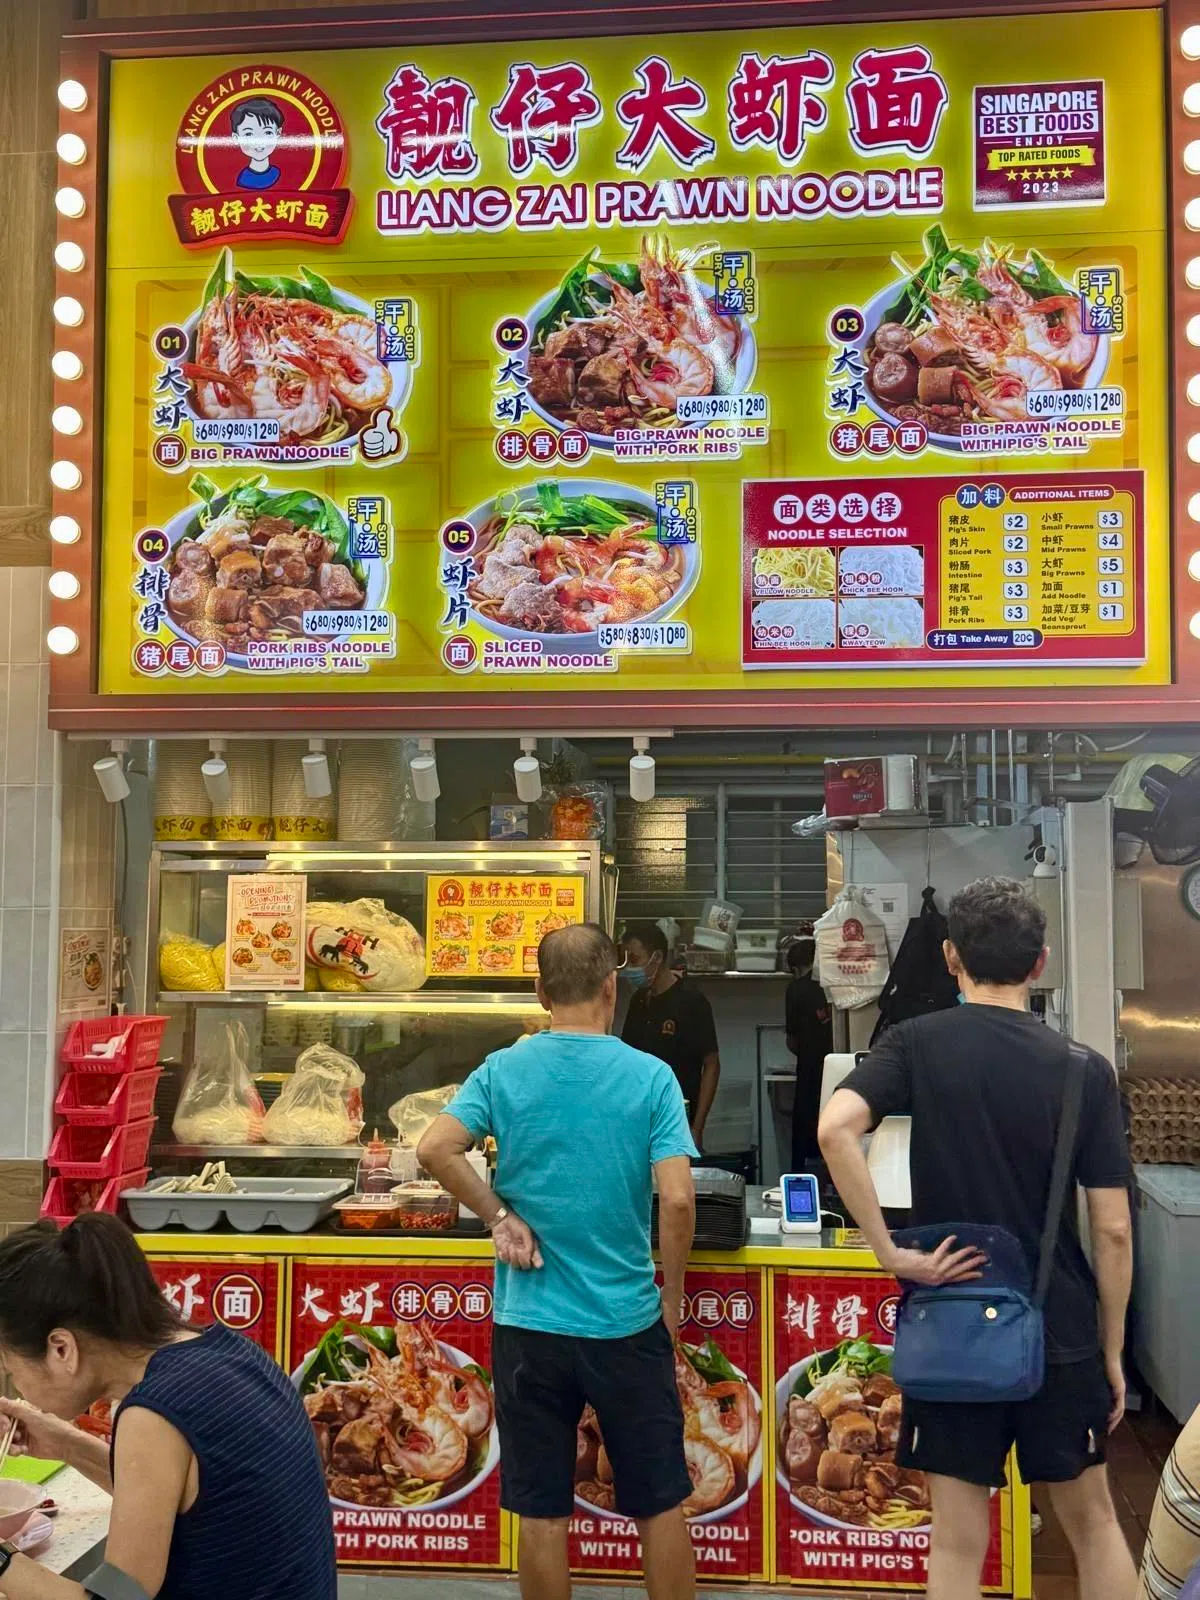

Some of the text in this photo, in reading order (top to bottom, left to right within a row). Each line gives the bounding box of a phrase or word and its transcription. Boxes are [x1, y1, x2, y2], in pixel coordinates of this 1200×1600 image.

[980, 90, 1098, 115] SINGAPORE
[182, 71, 341, 154] LIANG ZAI PRAWN NOODLE
[378, 47, 946, 177] 靓仔大虾面
[983, 112, 1094, 135] BEST FOODS
[1015, 135, 1064, 147] ENJOY
[998, 149, 1081, 163] TOP RATED FOODS
[1023, 181, 1059, 194] 2023
[381, 171, 942, 227] LIANG ZAI PRAWN NOODLE
[189, 196, 330, 236] 靓仔大虾面
[714, 254, 722, 278] DRY
[1080, 271, 1089, 295] DRY
[745, 278, 754, 312] SOUP
[375, 301, 386, 325] DRY
[1112, 296, 1122, 331] SOUP
[836, 319, 858, 332] 03
[404, 325, 415, 360] SOUP
[501, 329, 523, 342] 02
[160, 336, 180, 350] 01
[616, 427, 765, 441] BIG PRAWN NOODLE
[962, 420, 1121, 436] BIG PRAWN NOODLE
[837, 426, 921, 449] 猪尾面
[961, 436, 1087, 451] WITH PIG'S TAIL
[161, 441, 180, 461] 面
[190, 445, 350, 461] BIG PRAWN NOODLE
[502, 435, 584, 457] 排骨面
[616, 441, 738, 456] WITH PORK RIBS
[656, 483, 665, 506] DRY
[961, 488, 1001, 505] 加料
[1014, 489, 1110, 500] ADDITIONAL ITEMS
[349, 499, 358, 522] DRY
[779, 497, 897, 520] 面类选择
[949, 515, 970, 526] 猪皮
[1007, 515, 1024, 528] $2
[1042, 512, 1064, 523] 小虾
[1102, 513, 1119, 526] $3
[686, 508, 696, 542] SOUP
[1065, 523, 1094, 531] Prawns
[378, 524, 387, 557] SOUP
[448, 530, 469, 544] 05
[768, 527, 908, 540] NOODLE SELECTION
[1042, 535, 1064, 546] 中虾
[1102, 534, 1119, 547] $4
[142, 539, 164, 551] 04
[949, 537, 970, 548] 肉片
[1007, 537, 1024, 550] $2
[948, 548, 972, 556] Sliced
[949, 561, 970, 571] 粉肠
[1007, 561, 1023, 574] $3
[1042, 558, 1064, 569] 大虾
[1102, 558, 1119, 572] $5
[1041, 570, 1054, 578] Big
[949, 583, 970, 593] 猪尾
[1007, 584, 1023, 597] $3
[1042, 581, 1063, 591] 加面
[1102, 582, 1117, 595] $1
[949, 606, 970, 616] 排骨
[1007, 606, 1023, 619] $3
[1042, 604, 1091, 614] 加菜/豆芽
[1102, 605, 1117, 617] $1
[1041, 623, 1087, 631] Beansprout
[933, 633, 958, 646] 打包
[960, 634, 1008, 644] Take Away
[249, 642, 389, 654] PORK RIBS NOODLE
[451, 643, 469, 662] 面
[484, 642, 542, 653] SLICED
[141, 646, 219, 665] 猪尾面
[249, 657, 362, 668] WITH PIG'S TAIL
[484, 655, 613, 668] PRAWN NOODLE
[469, 881, 552, 898] 靓仔大虾面
[222, 1286, 254, 1319] 面
[298, 1283, 486, 1324] 大虾 排骨面
[782, 1293, 868, 1339] 排骨
[333, 1511, 486, 1529] PRAWN NOODLE
[686, 1525, 749, 1541] OODL
[847, 1531, 894, 1547] RIBS
[365, 1534, 417, 1549] PORK
[424, 1535, 468, 1550] RIBS
[580, 1541, 630, 1557] WITH
[693, 1547, 736, 1562] TAIL
[803, 1551, 855, 1567] WITH
[862, 1553, 914, 1570] PIG'S
